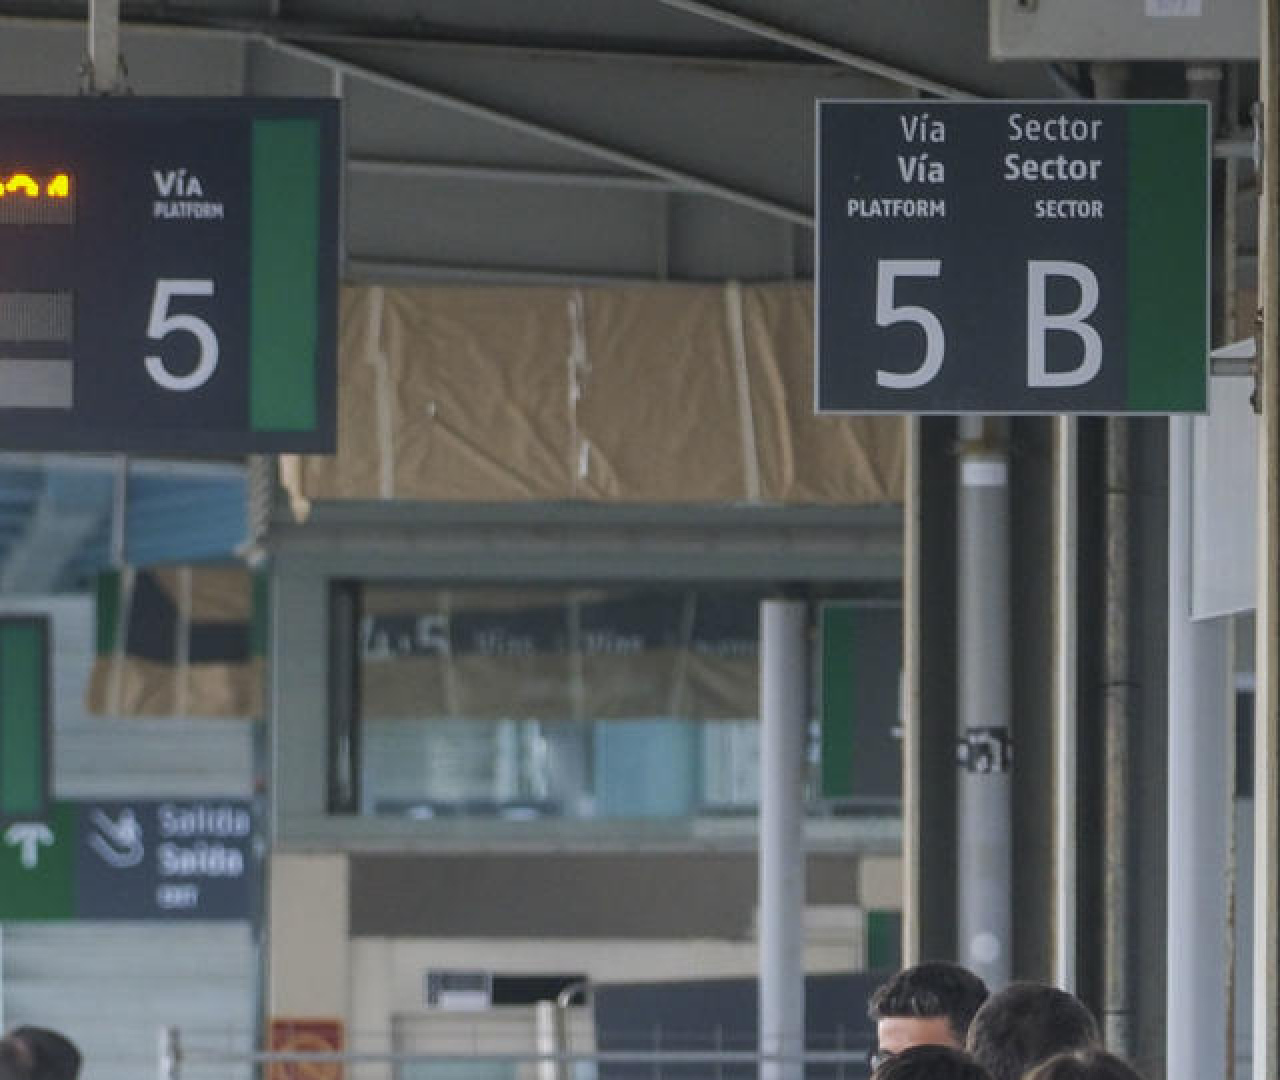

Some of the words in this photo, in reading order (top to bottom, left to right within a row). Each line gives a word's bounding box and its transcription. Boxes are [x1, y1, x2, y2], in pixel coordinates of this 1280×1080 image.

[900, 114, 945, 142] Vía
[1009, 114, 1102, 142] Sector
[898, 153, 945, 183] Vía
[1004, 154, 1102, 181] Sector
[154, 202, 223, 218] PLATFORM
[848, 200, 945, 217] PLATFORM
[1035, 201, 1103, 217] SECTOR
[144, 279, 219, 391] 5
[876, 260, 945, 389] 5
[1027, 260, 1103, 388] B
